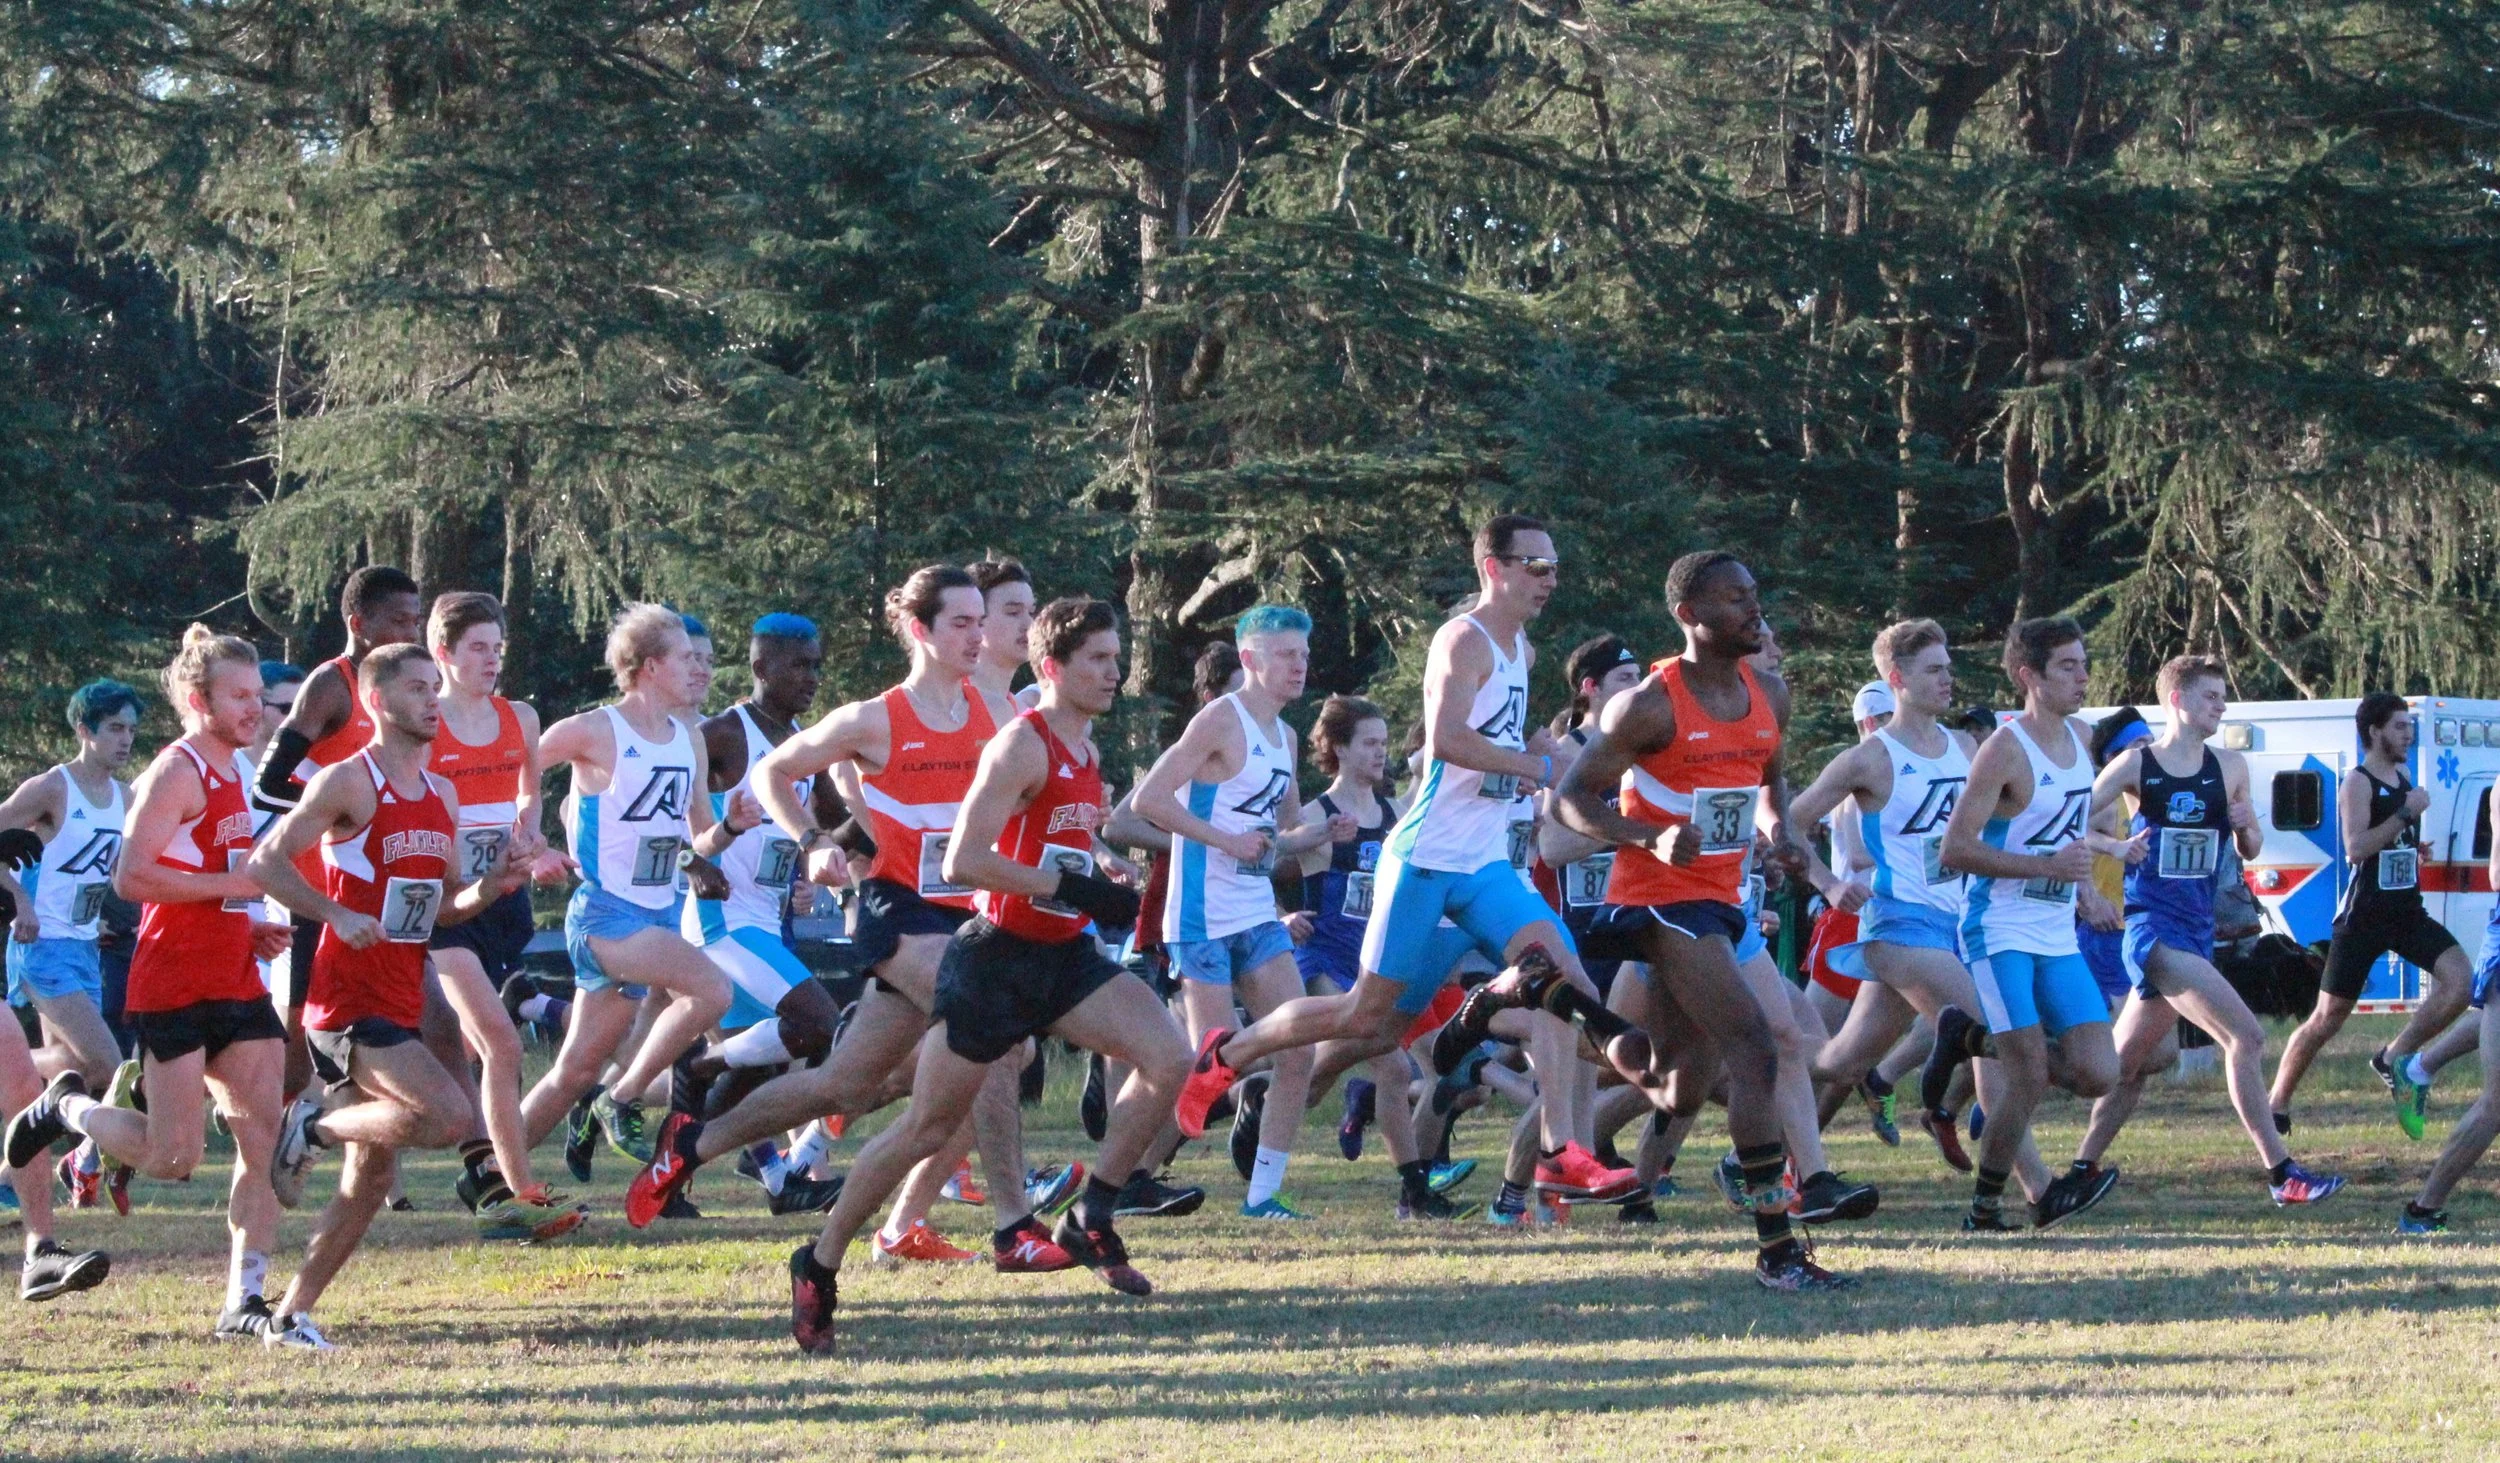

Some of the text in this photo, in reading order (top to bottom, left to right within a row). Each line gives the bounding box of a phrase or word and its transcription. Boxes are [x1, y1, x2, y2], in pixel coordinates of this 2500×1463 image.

[441, 766, 492, 777] LAYTON
[902, 761, 961, 772] CLAYTON
[1683, 751, 1738, 763] CLAYTON
[619, 766, 690, 821] A
[1711, 808, 1741, 843] 33
[471, 844, 498, 875] 29
[652, 852, 670, 881] 11
[771, 852, 793, 882] 15
[2173, 845, 2206, 871] 111
[1584, 871, 1606, 897] 87
[401, 899, 427, 934] 72
